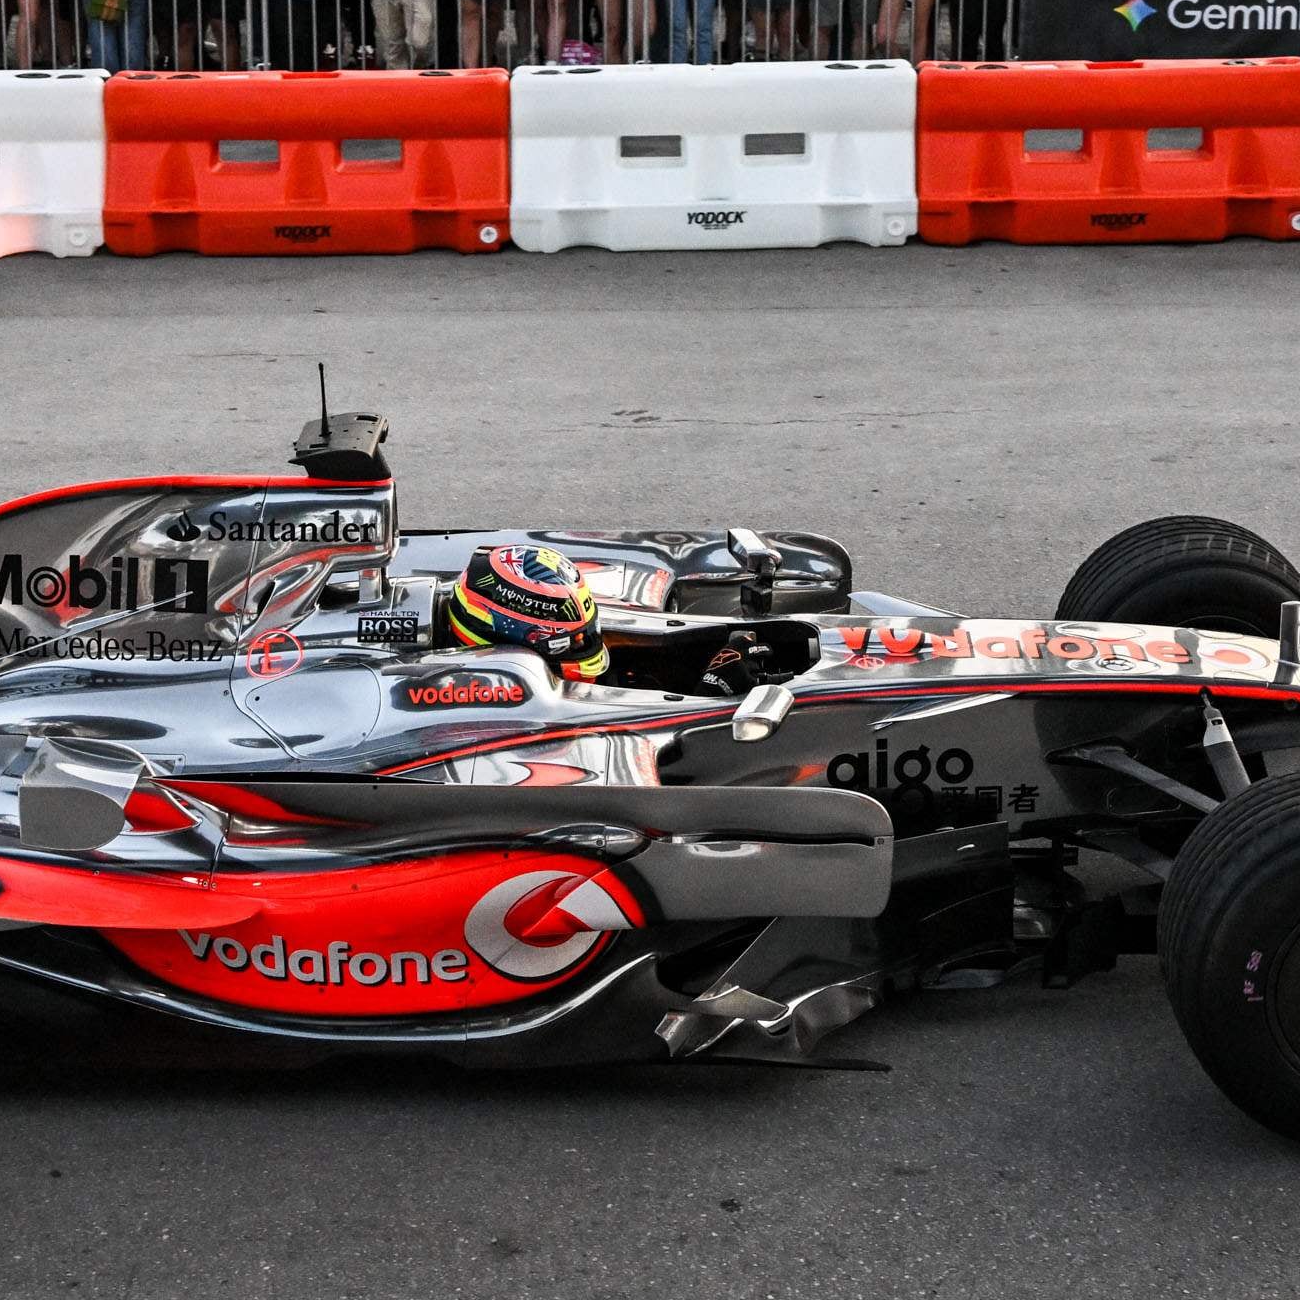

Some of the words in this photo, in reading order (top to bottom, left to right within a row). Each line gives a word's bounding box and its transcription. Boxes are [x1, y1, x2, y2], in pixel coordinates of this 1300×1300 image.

[687, 210, 748, 225] YODOCK
[207, 511, 377, 543] Santander
[361, 619, 415, 636] BOSS
[838, 626, 1192, 665] vodafone
[408, 680, 524, 705] vodafone
[826, 738, 974, 812] aigo
[177, 927, 469, 986] vodafone
